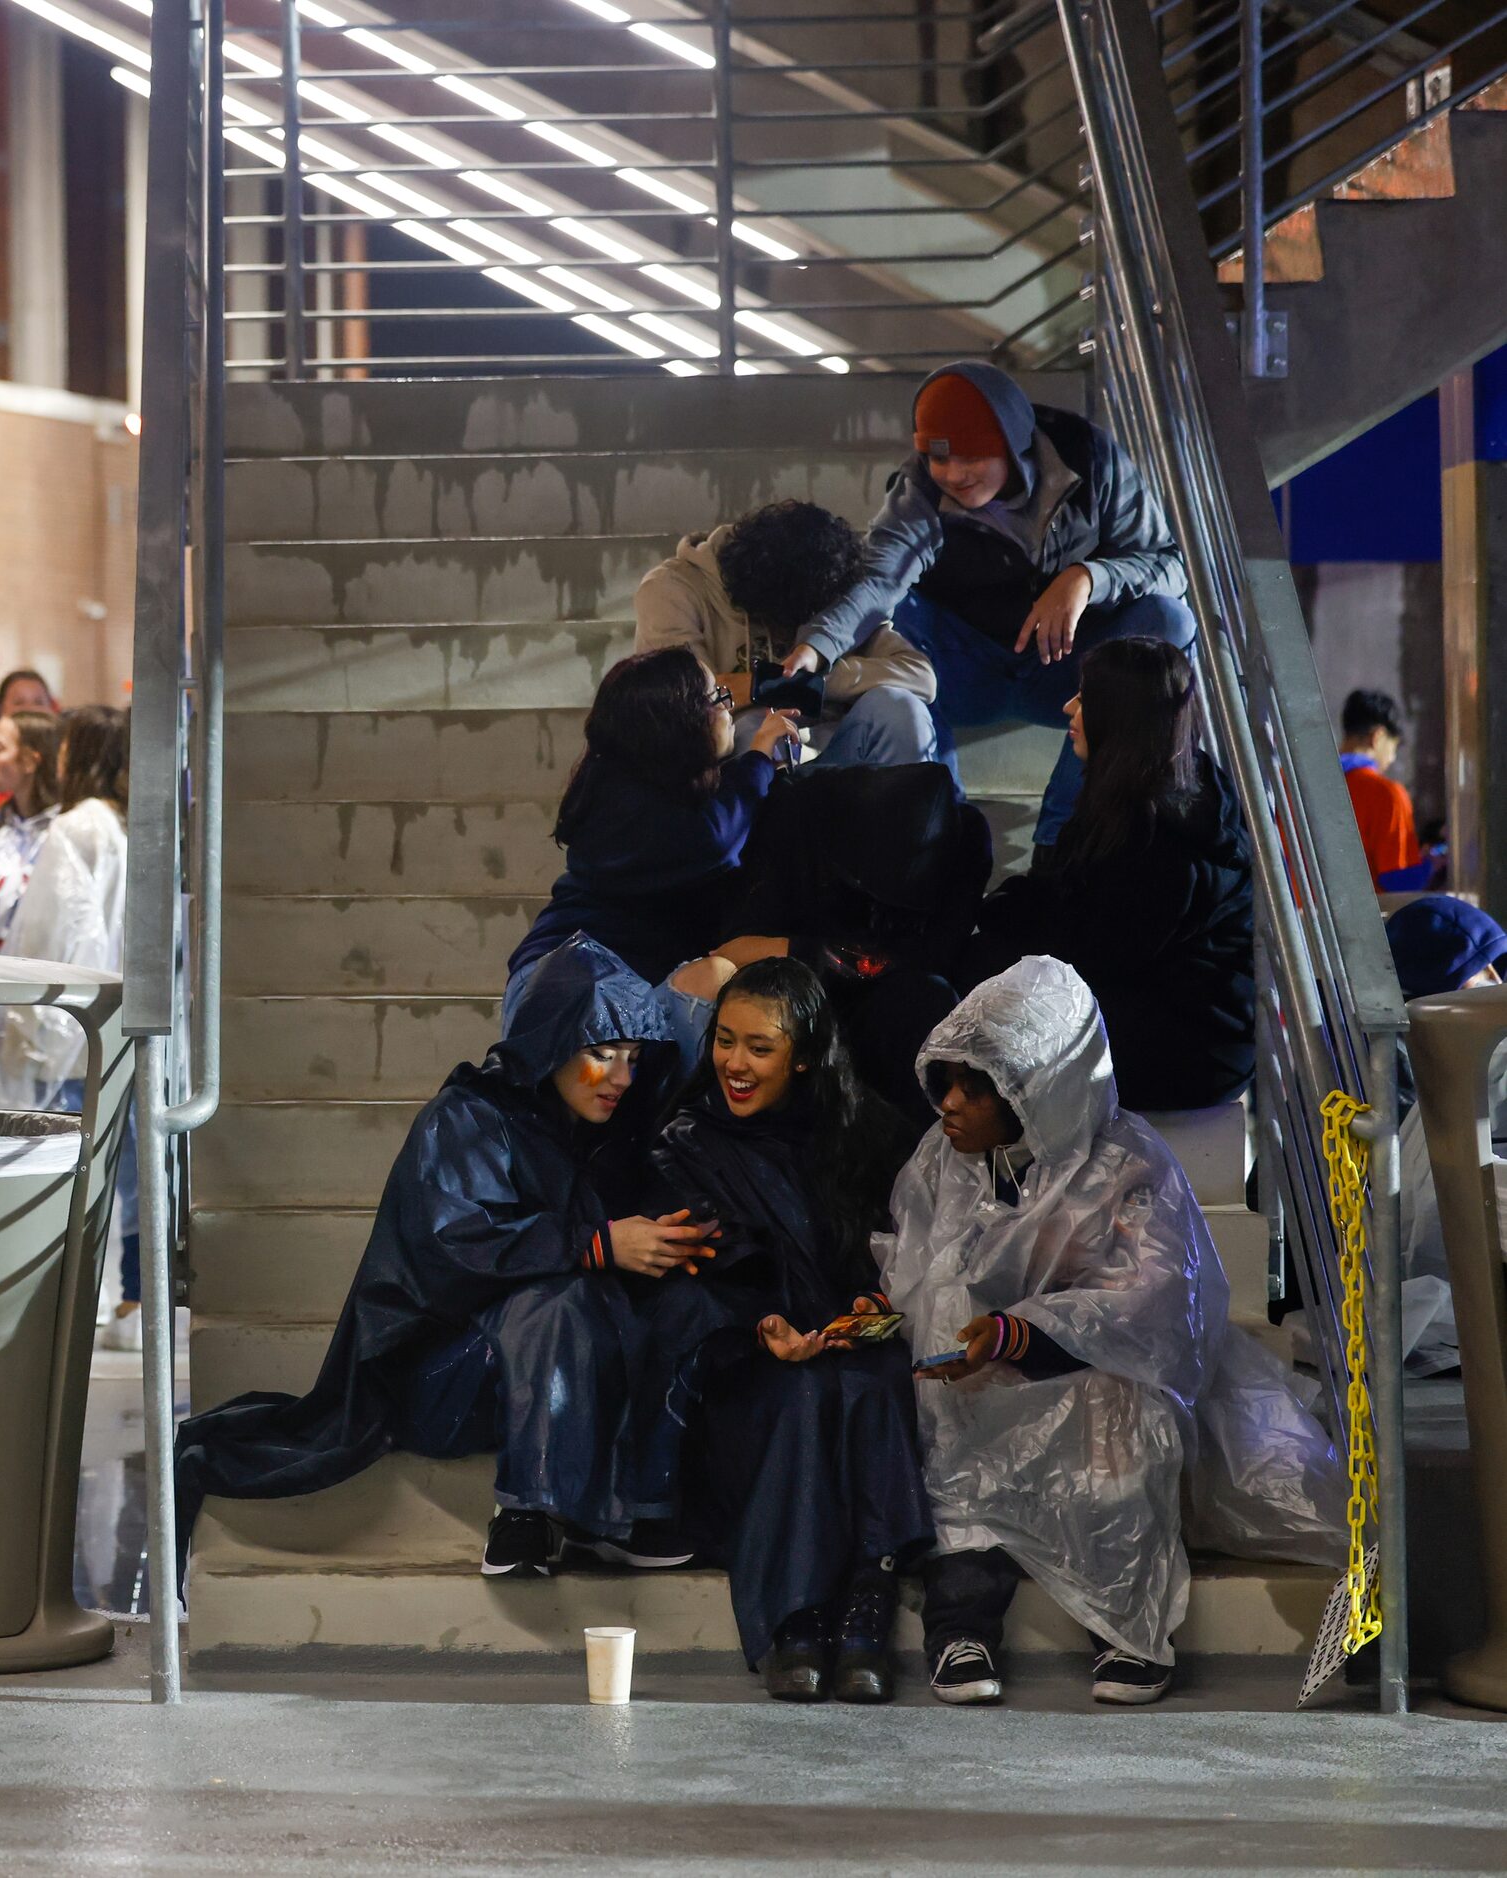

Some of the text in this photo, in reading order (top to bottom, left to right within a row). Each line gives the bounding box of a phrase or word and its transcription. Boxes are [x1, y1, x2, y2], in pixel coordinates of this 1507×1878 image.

[1311, 1592, 1343, 1679] THIS EVENT
[1323, 1639, 1340, 1669] FOR
